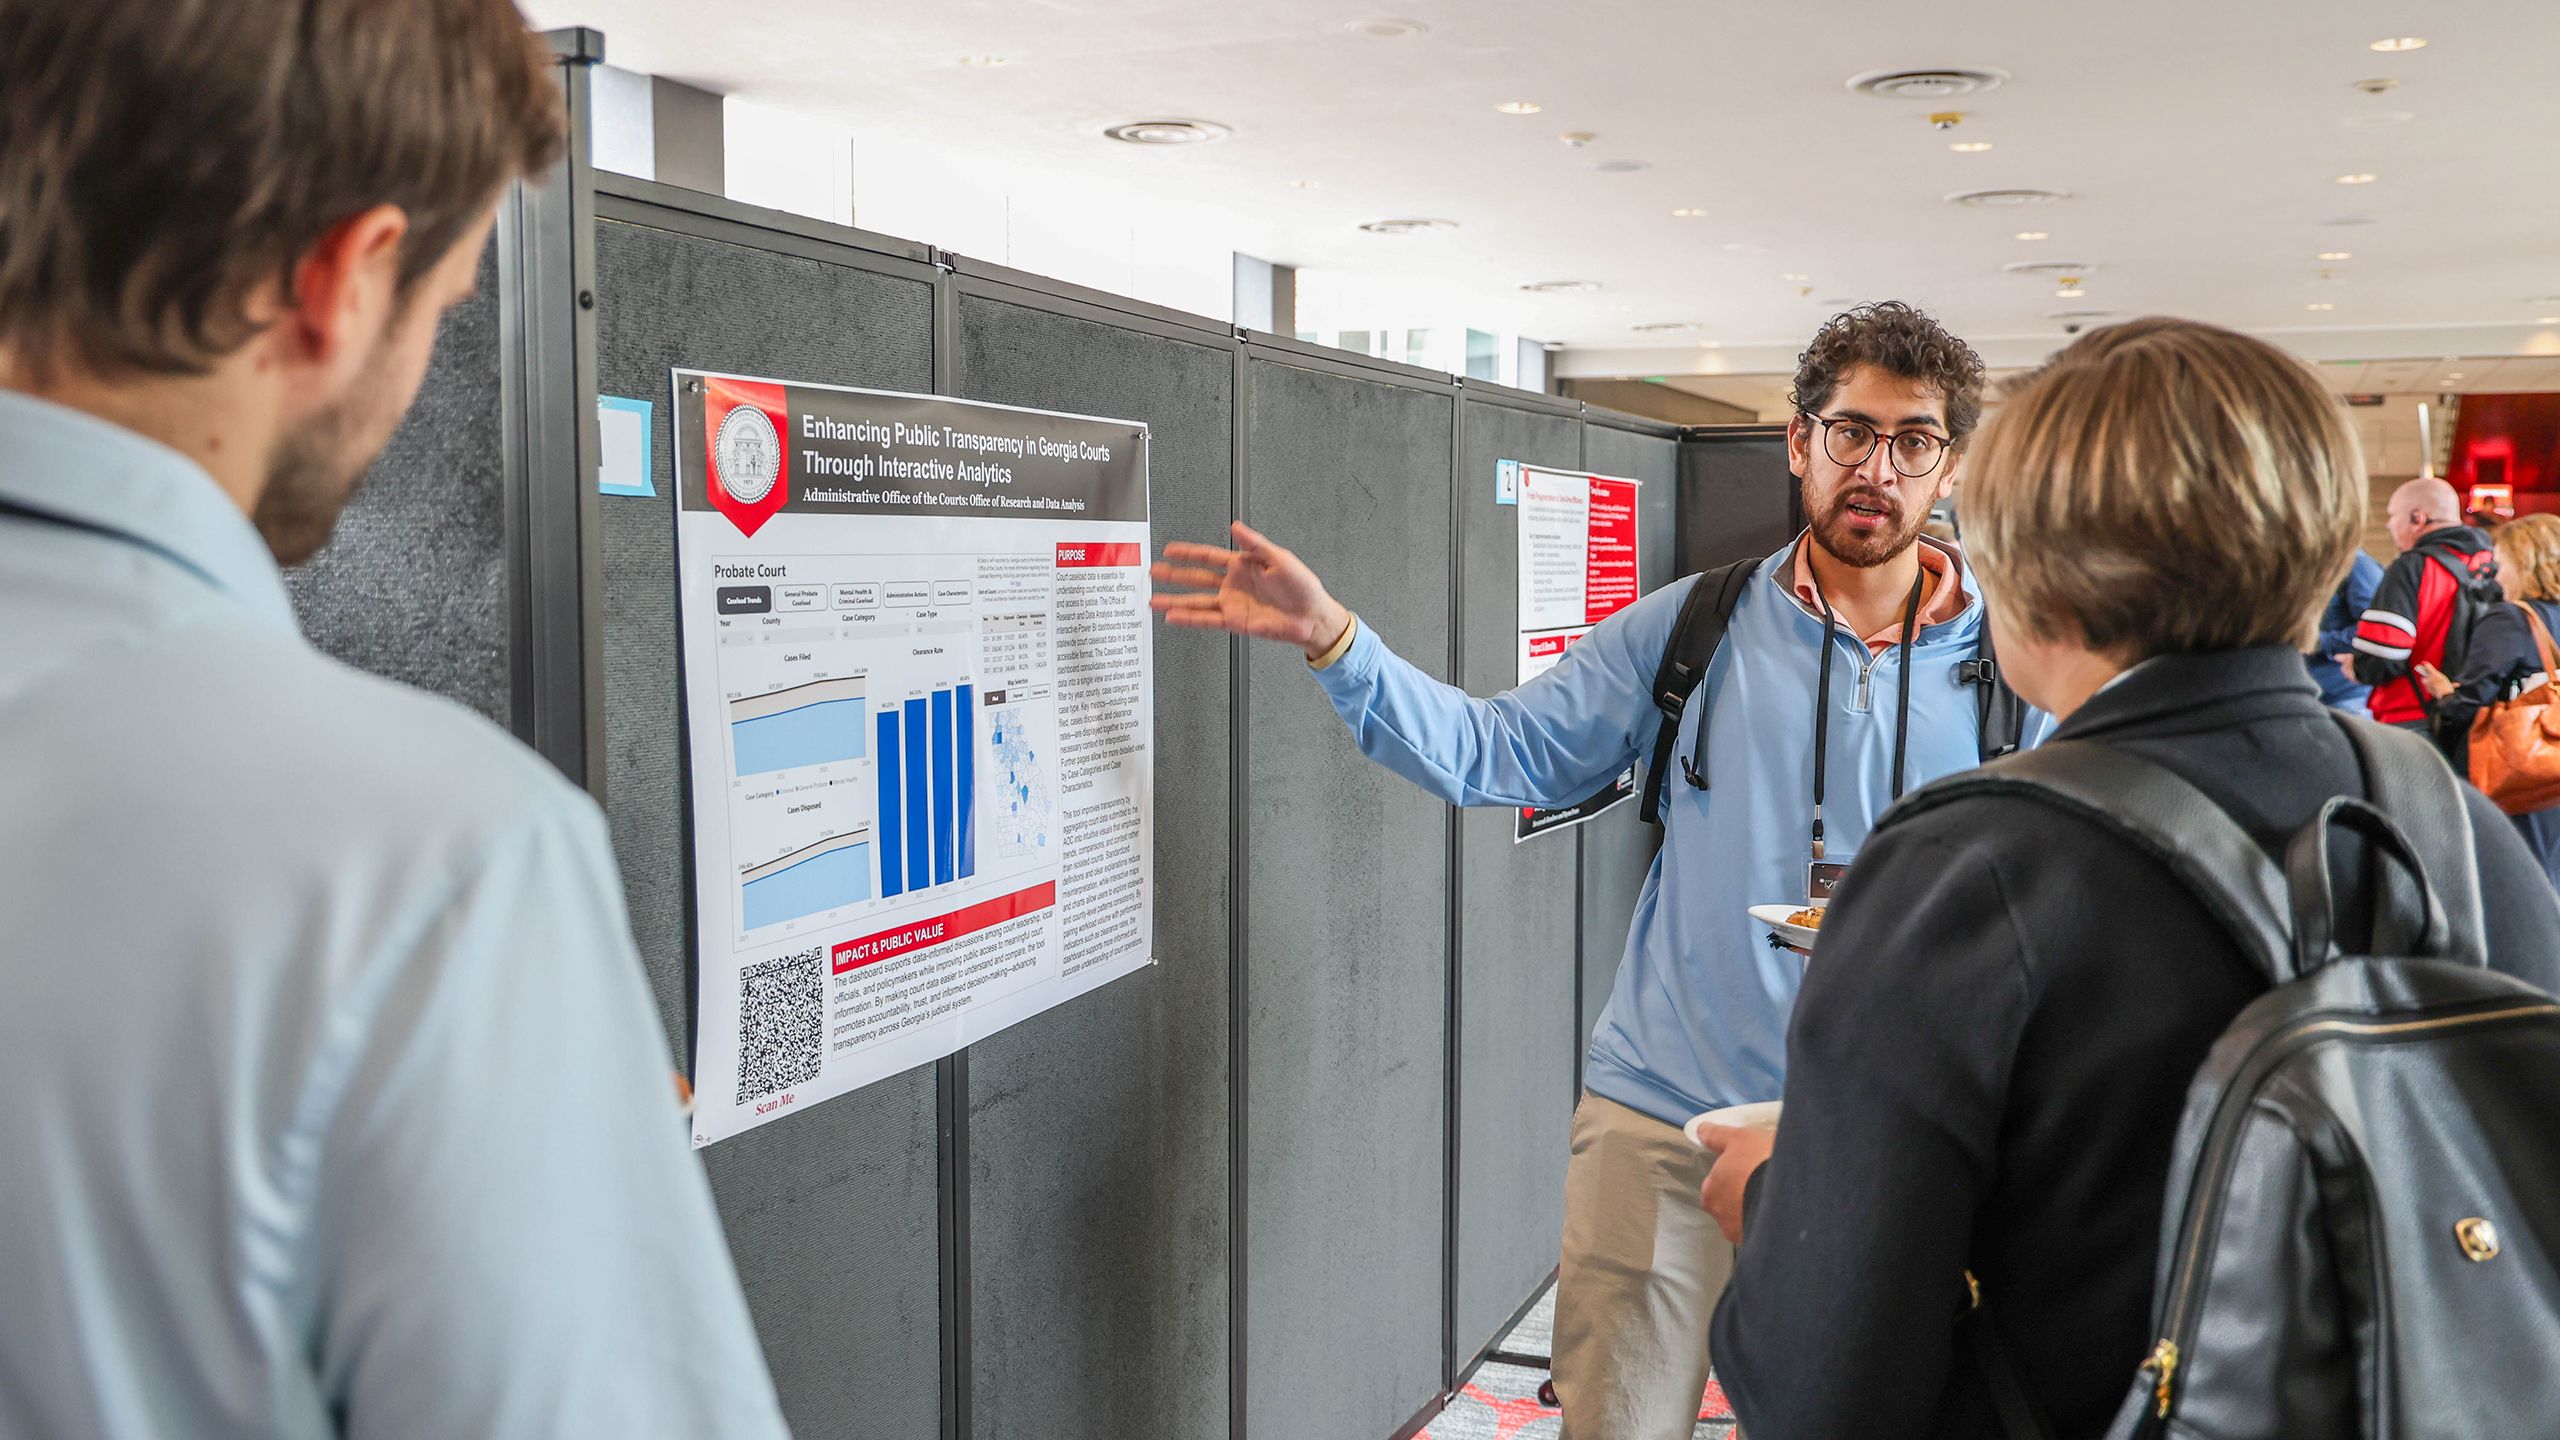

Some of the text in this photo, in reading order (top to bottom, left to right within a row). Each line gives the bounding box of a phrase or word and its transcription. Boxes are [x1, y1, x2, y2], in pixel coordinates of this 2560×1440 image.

[803, 414, 890, 448] Enhancing
[895, 422, 940, 447] Public
[943, 427, 1023, 459] Transparency
[1026, 435, 1036, 455] in
[1039, 436, 1077, 463] Georgia
[1080, 441, 1109, 462] Courts
[803, 450, 873, 481] Through
[879, 455, 953, 480] Interactive
[957, 460, 1011, 487] Analytics
[803, 488, 1084, 512] Administrative Office of the Courts: Office of Research and Data Analysis
[715, 564, 786, 578] Probate Court
[1058, 550, 1085, 560] PURPOSE
[855, 614, 875, 622] Category
[756, 791, 773, 800] Category
[801, 802, 821, 812] Disposed
[834, 909, 1052, 989] The dashboard supports data-informed discussions among court leadership, local
[836, 923, 943, 966] IMPACT & PUBLIC VALUE
[834, 926, 1043, 1004] officials, and policymakers while improving public access to meaningful court
[834, 940, 1045, 1020] information. By making court data easier to understand and compare, the tool
[834, 1018, 865, 1037] promotes
[867, 1001, 912, 1024] accountability,
[914, 997, 927, 1007] trust,
[930, 990, 941, 1003] and
[942, 981, 966, 997] informed
[834, 996, 972, 1051] transparency across Georgia's judicial system.
[756, 1094, 794, 1116] Scan Me
